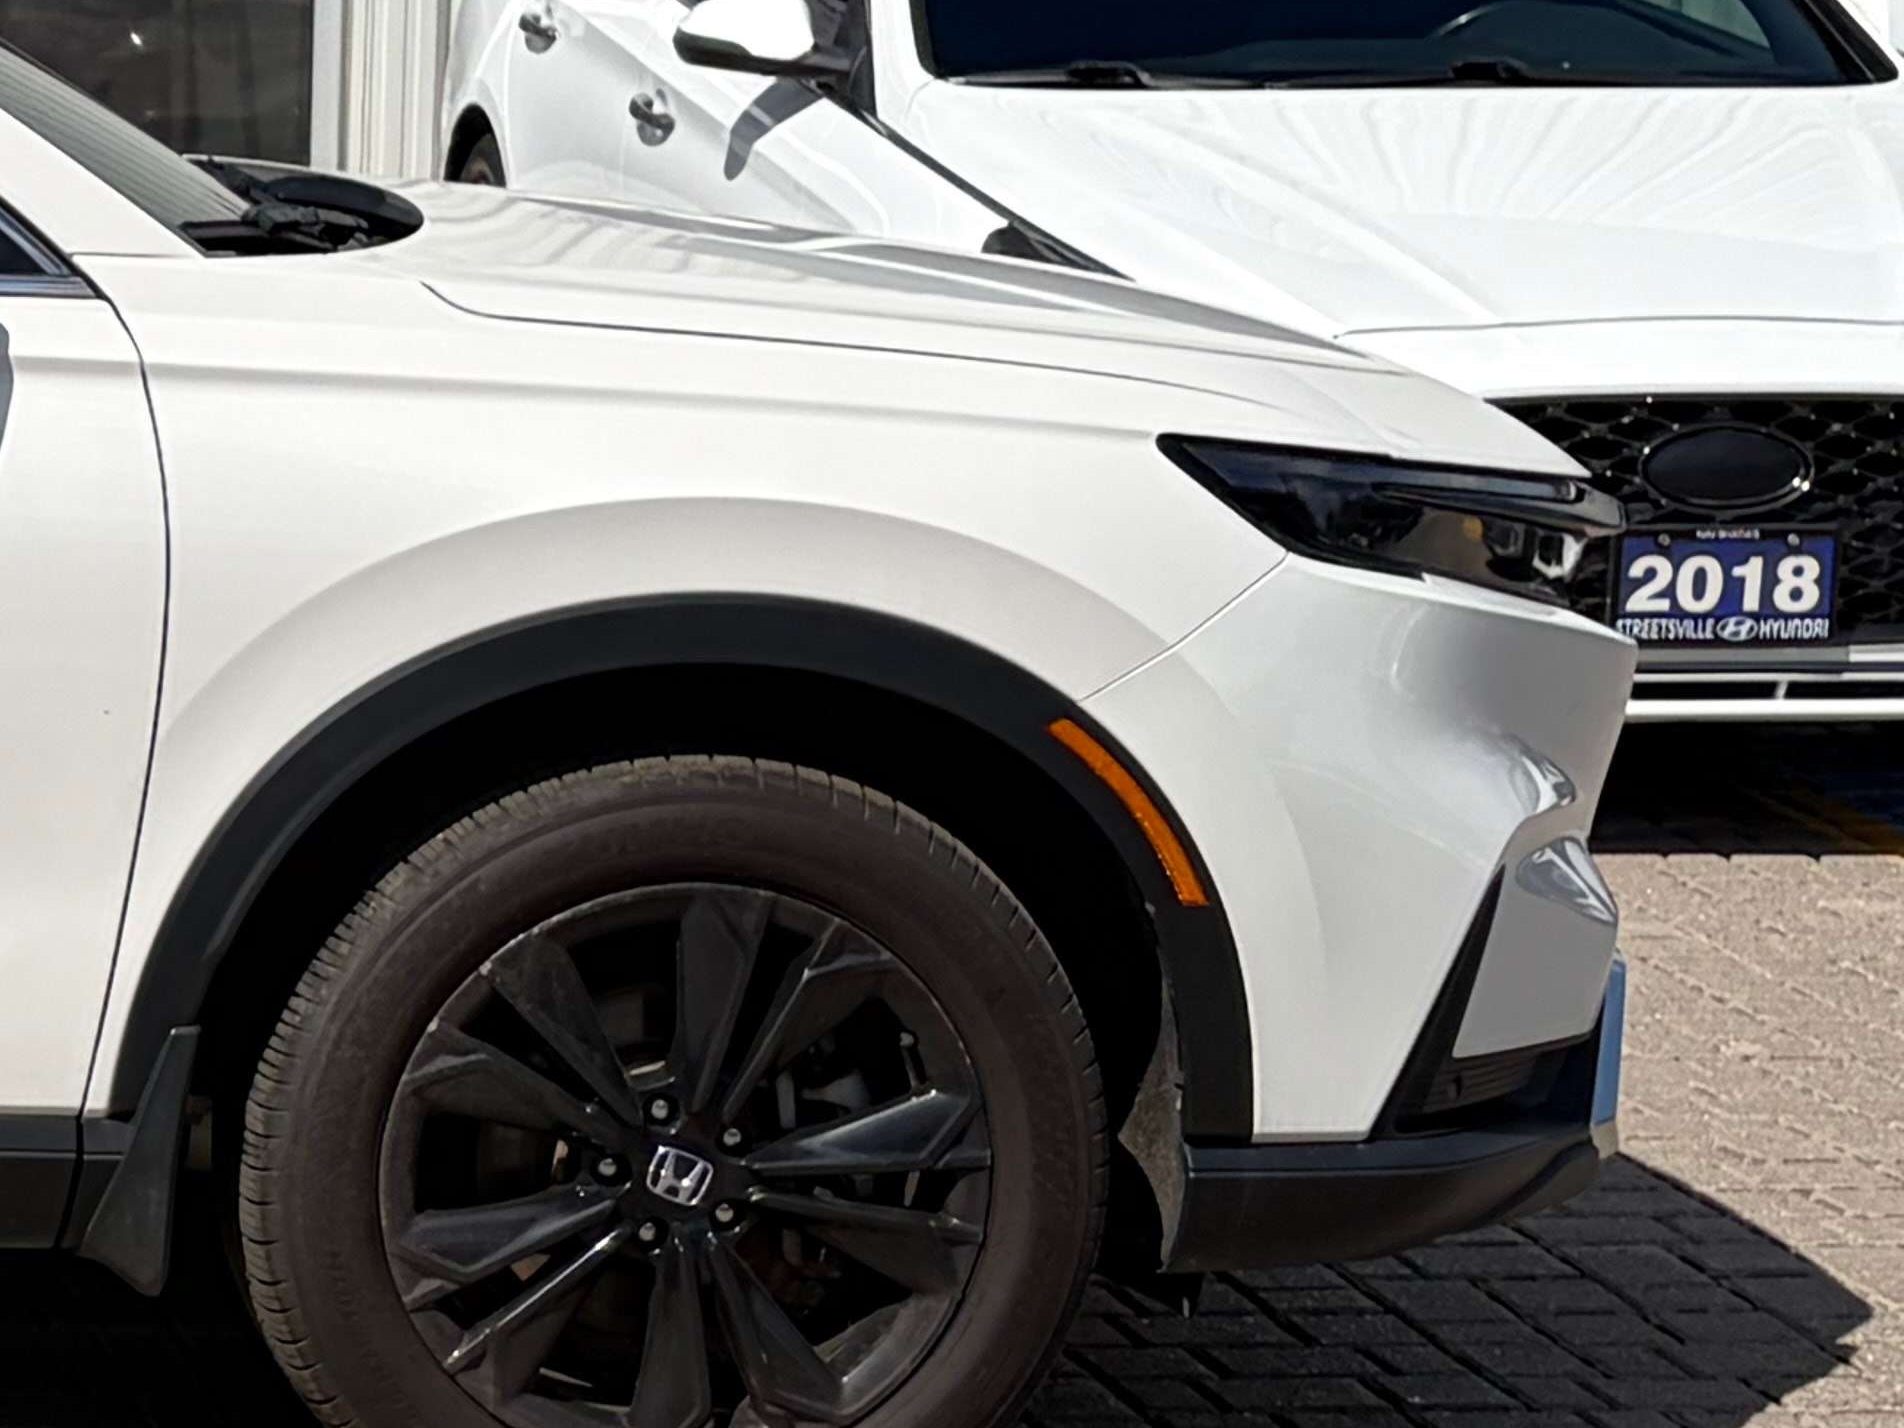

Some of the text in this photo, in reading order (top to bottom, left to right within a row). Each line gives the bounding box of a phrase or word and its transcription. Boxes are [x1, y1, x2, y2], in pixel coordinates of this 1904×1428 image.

[1624, 554, 1821, 614] 2018
[1615, 618, 1830, 640] STREETSVILLE HYUNDAI
